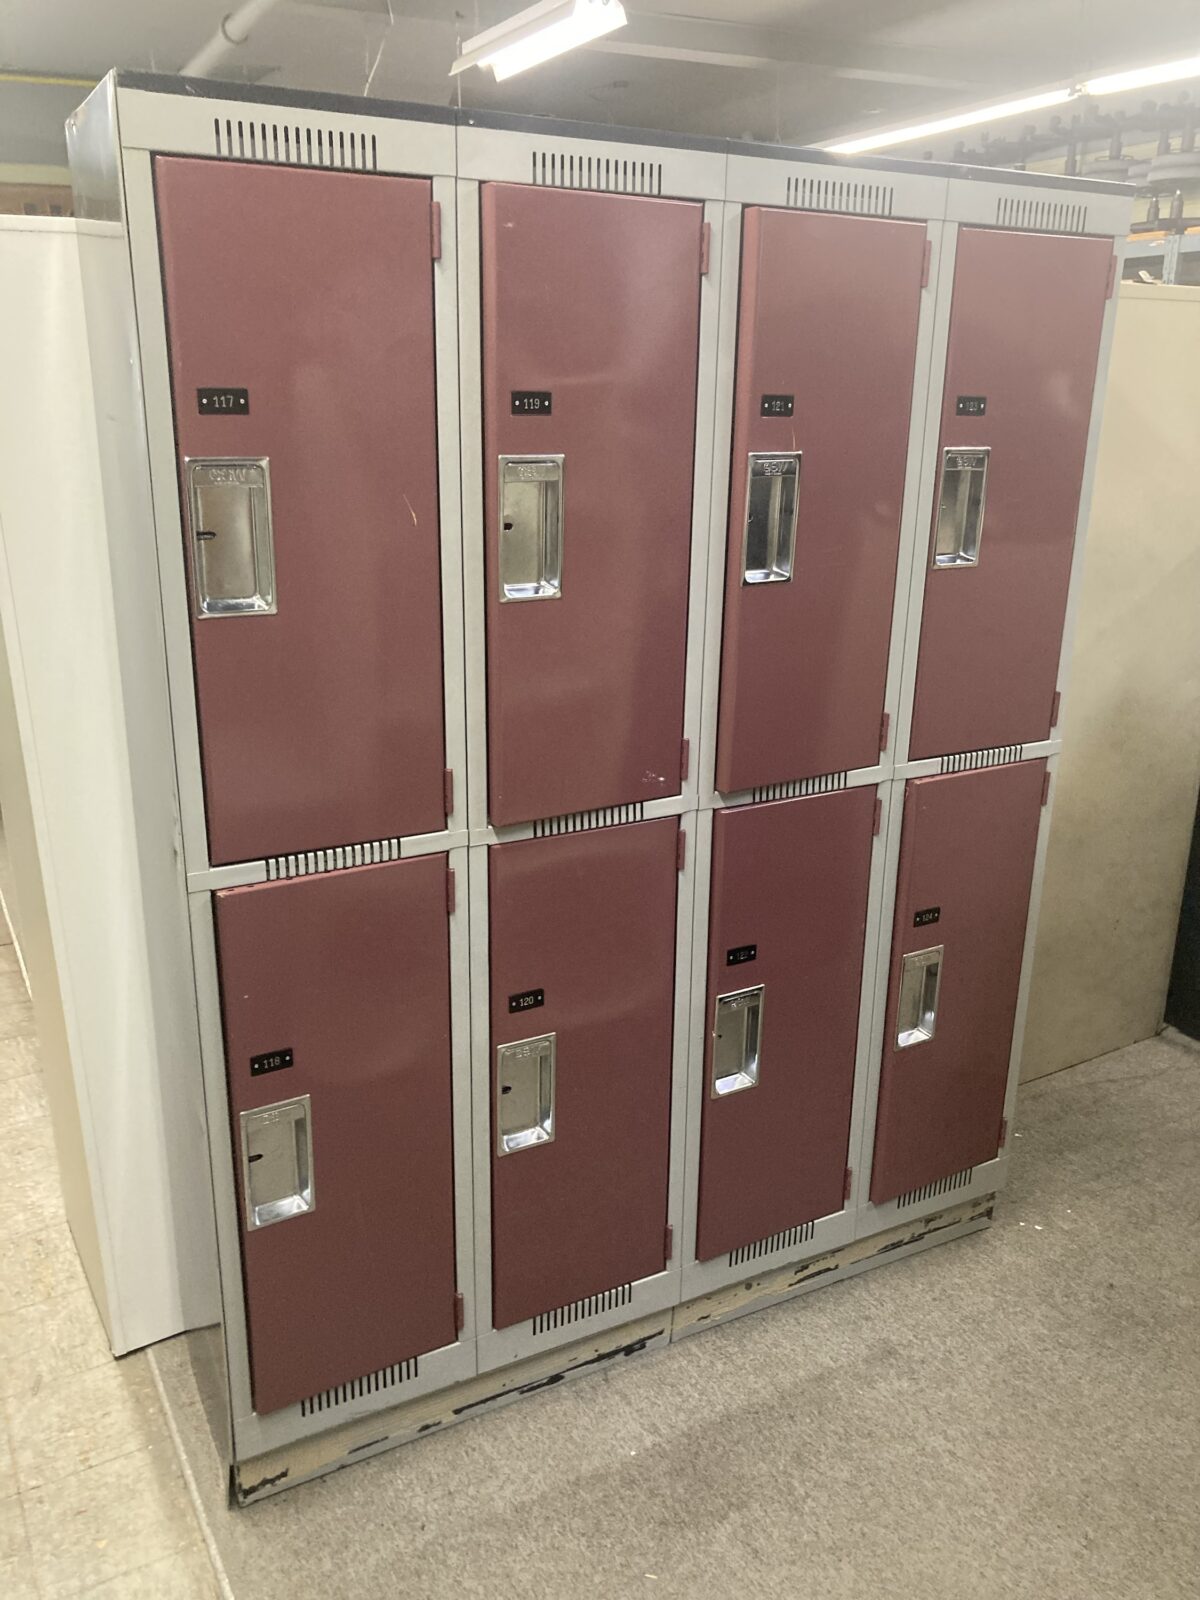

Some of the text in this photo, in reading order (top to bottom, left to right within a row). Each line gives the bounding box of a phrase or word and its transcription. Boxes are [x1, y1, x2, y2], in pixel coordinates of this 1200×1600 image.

[213, 395, 234, 408] 117
[523, 397, 540, 410] 119
[771, 401, 785, 411] 121
[519, 996, 534, 1007] 120
[263, 1056, 280, 1069] 118
